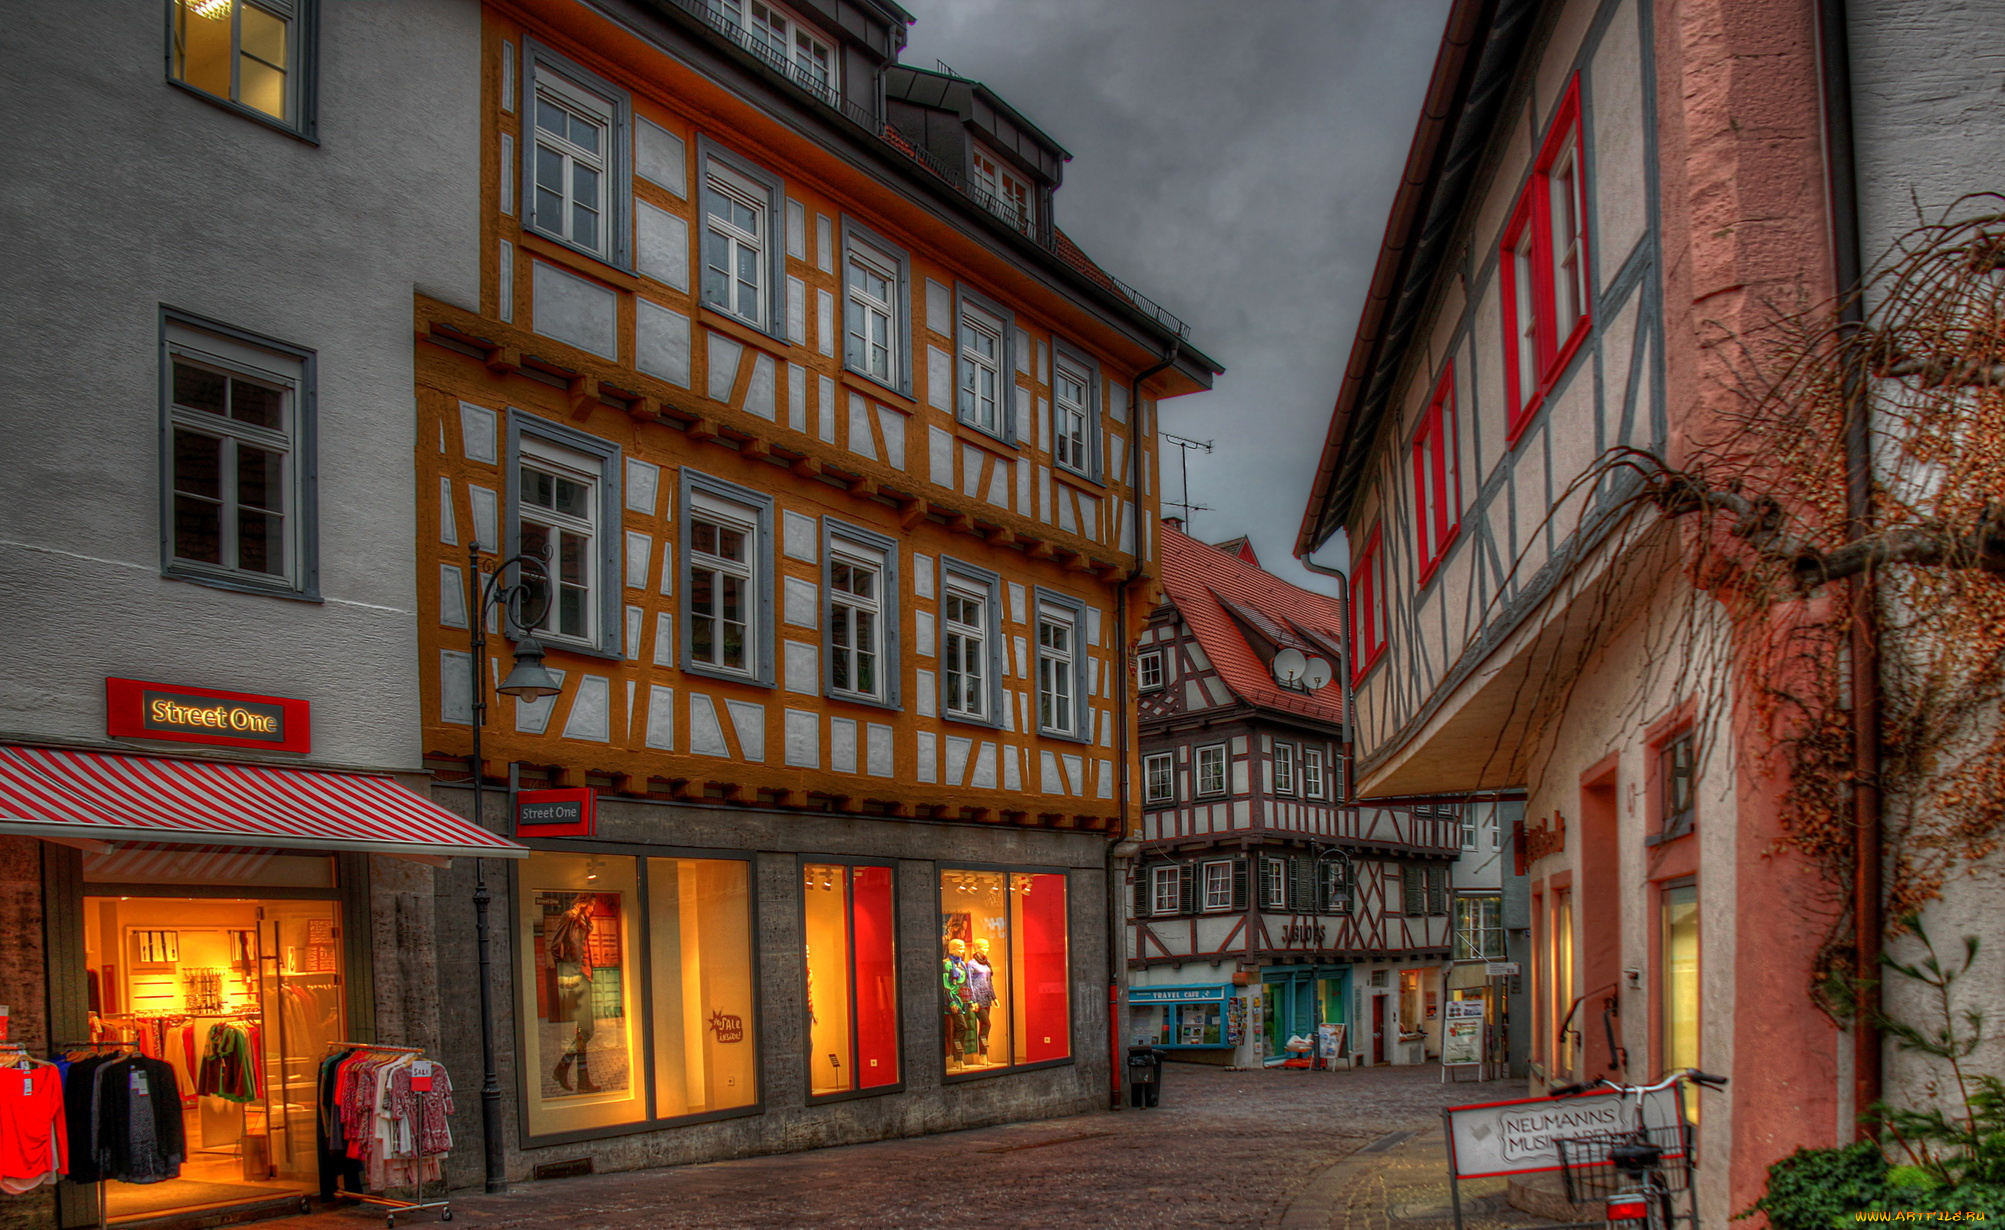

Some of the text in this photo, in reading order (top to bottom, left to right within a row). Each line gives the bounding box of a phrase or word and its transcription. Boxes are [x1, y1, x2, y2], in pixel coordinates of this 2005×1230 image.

[152, 699, 278, 733] Street One
[522, 806, 577, 819] Street One
[1152, 991, 1180, 999] TRAVEL
[413, 1067, 429, 1076] SALE
[1506, 1108, 1616, 1135] NEUMANNS
